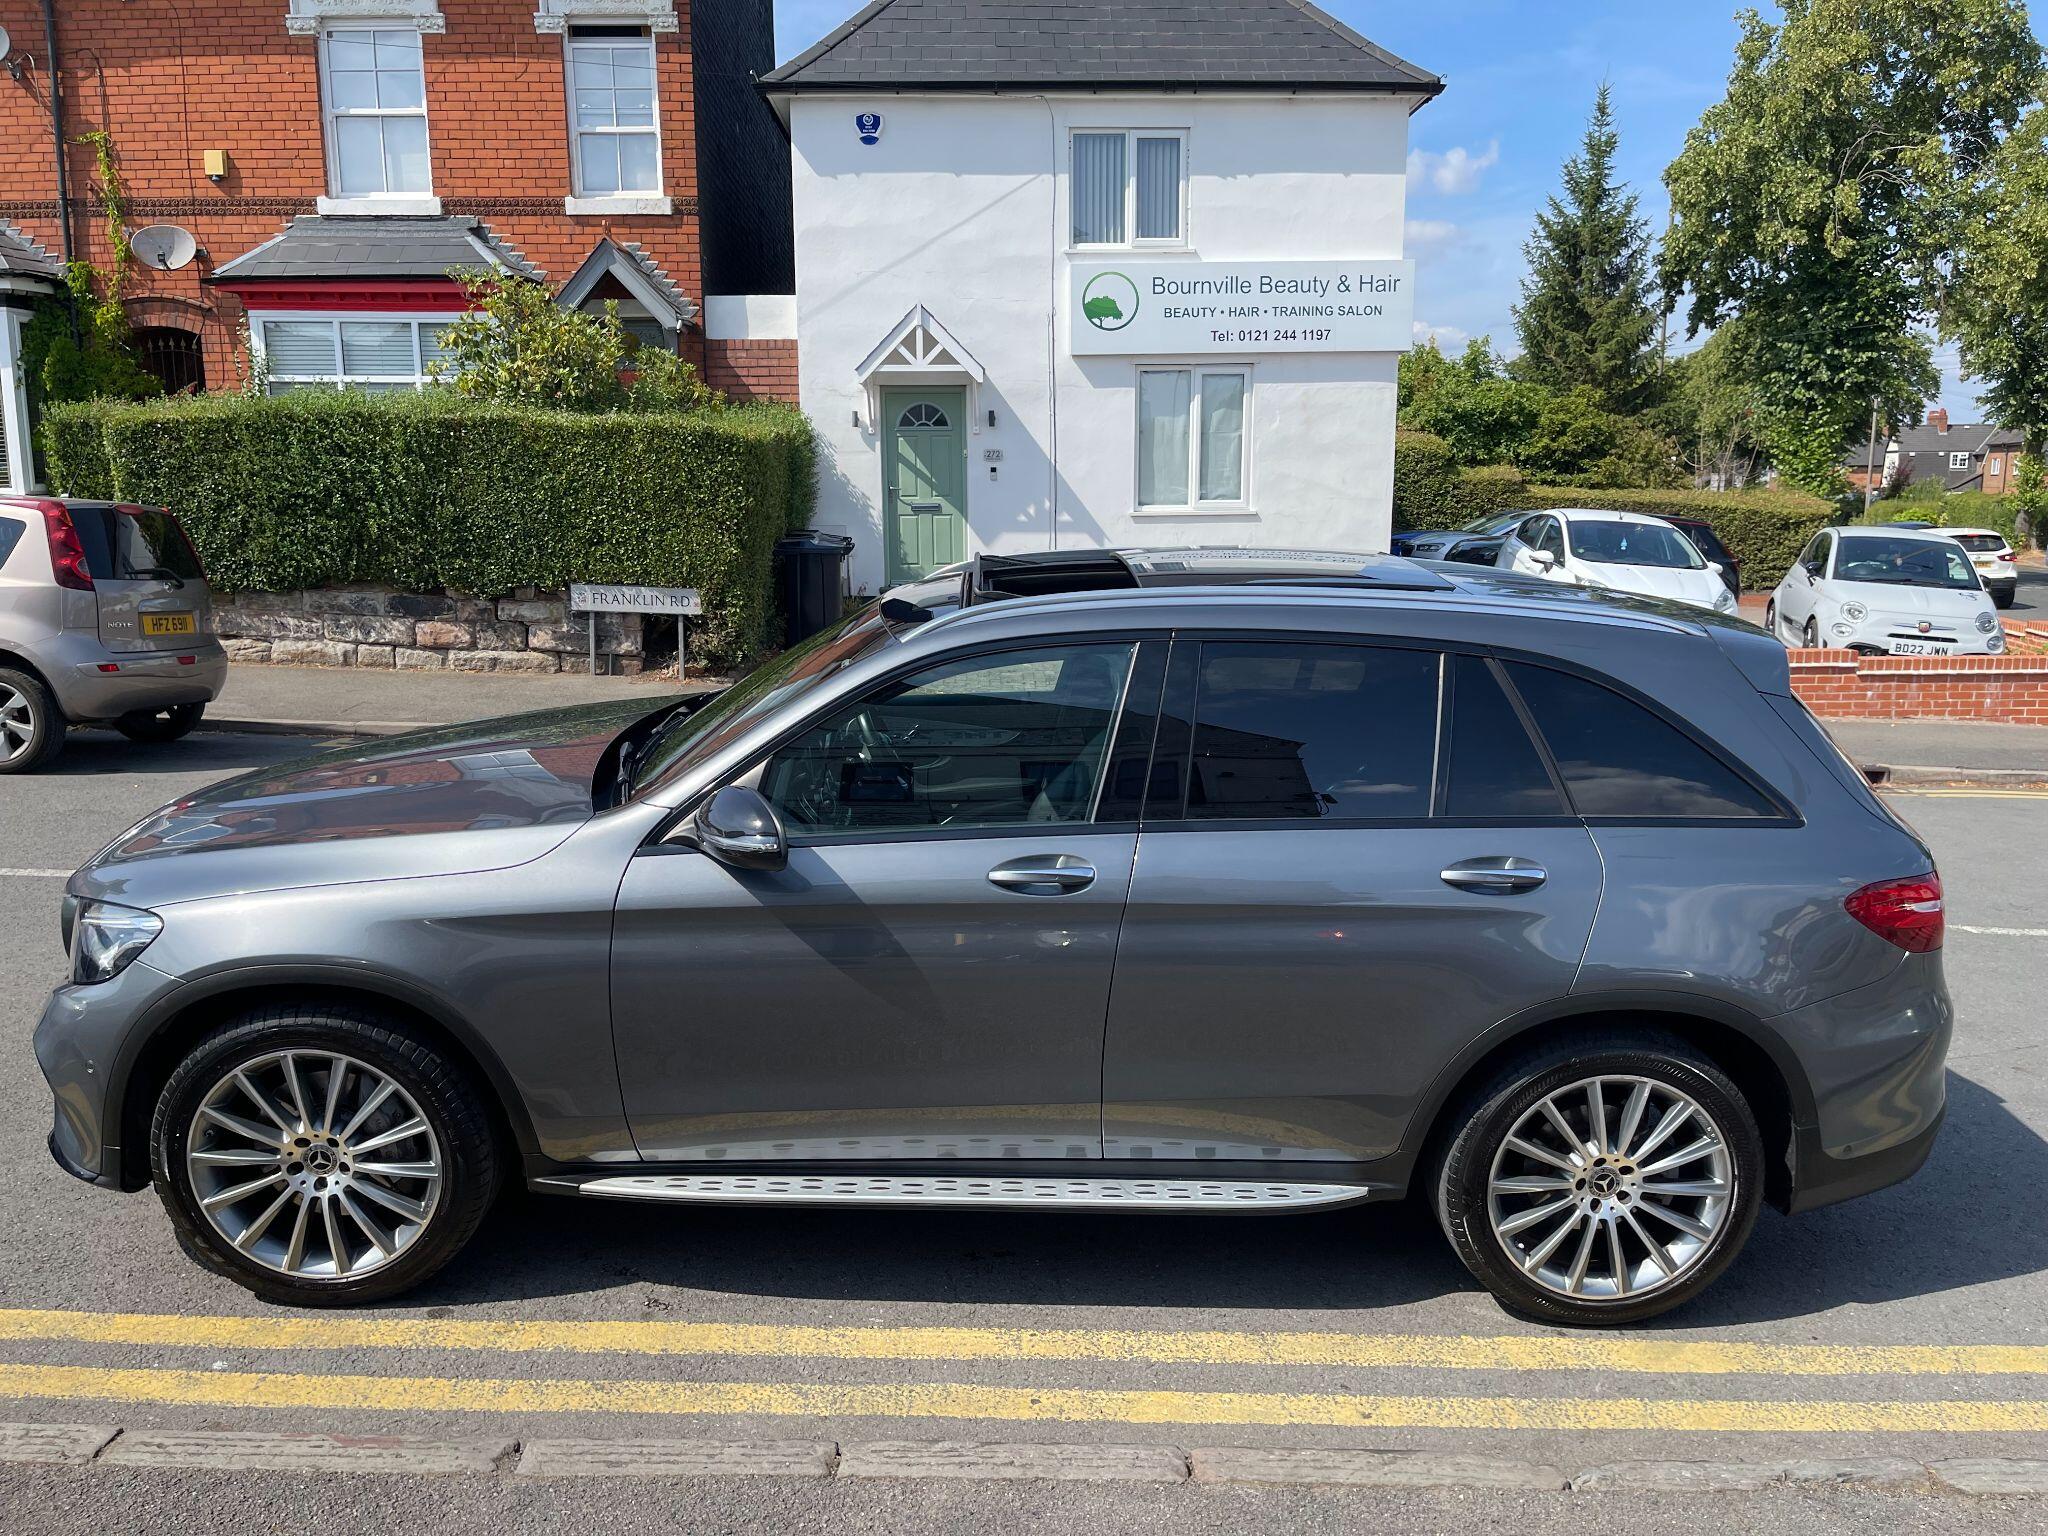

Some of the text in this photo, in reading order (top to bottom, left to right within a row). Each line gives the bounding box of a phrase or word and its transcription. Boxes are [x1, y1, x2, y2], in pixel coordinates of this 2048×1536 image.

[1151, 274, 1401, 298] Bournville Beauty & Hair
[1163, 304, 1383, 319] BEAUTY HAIR TRAINING SALON
[1210, 329, 1331, 343] Tel: 0121 244 1197
[591, 592, 666, 607] FRANKLIN
